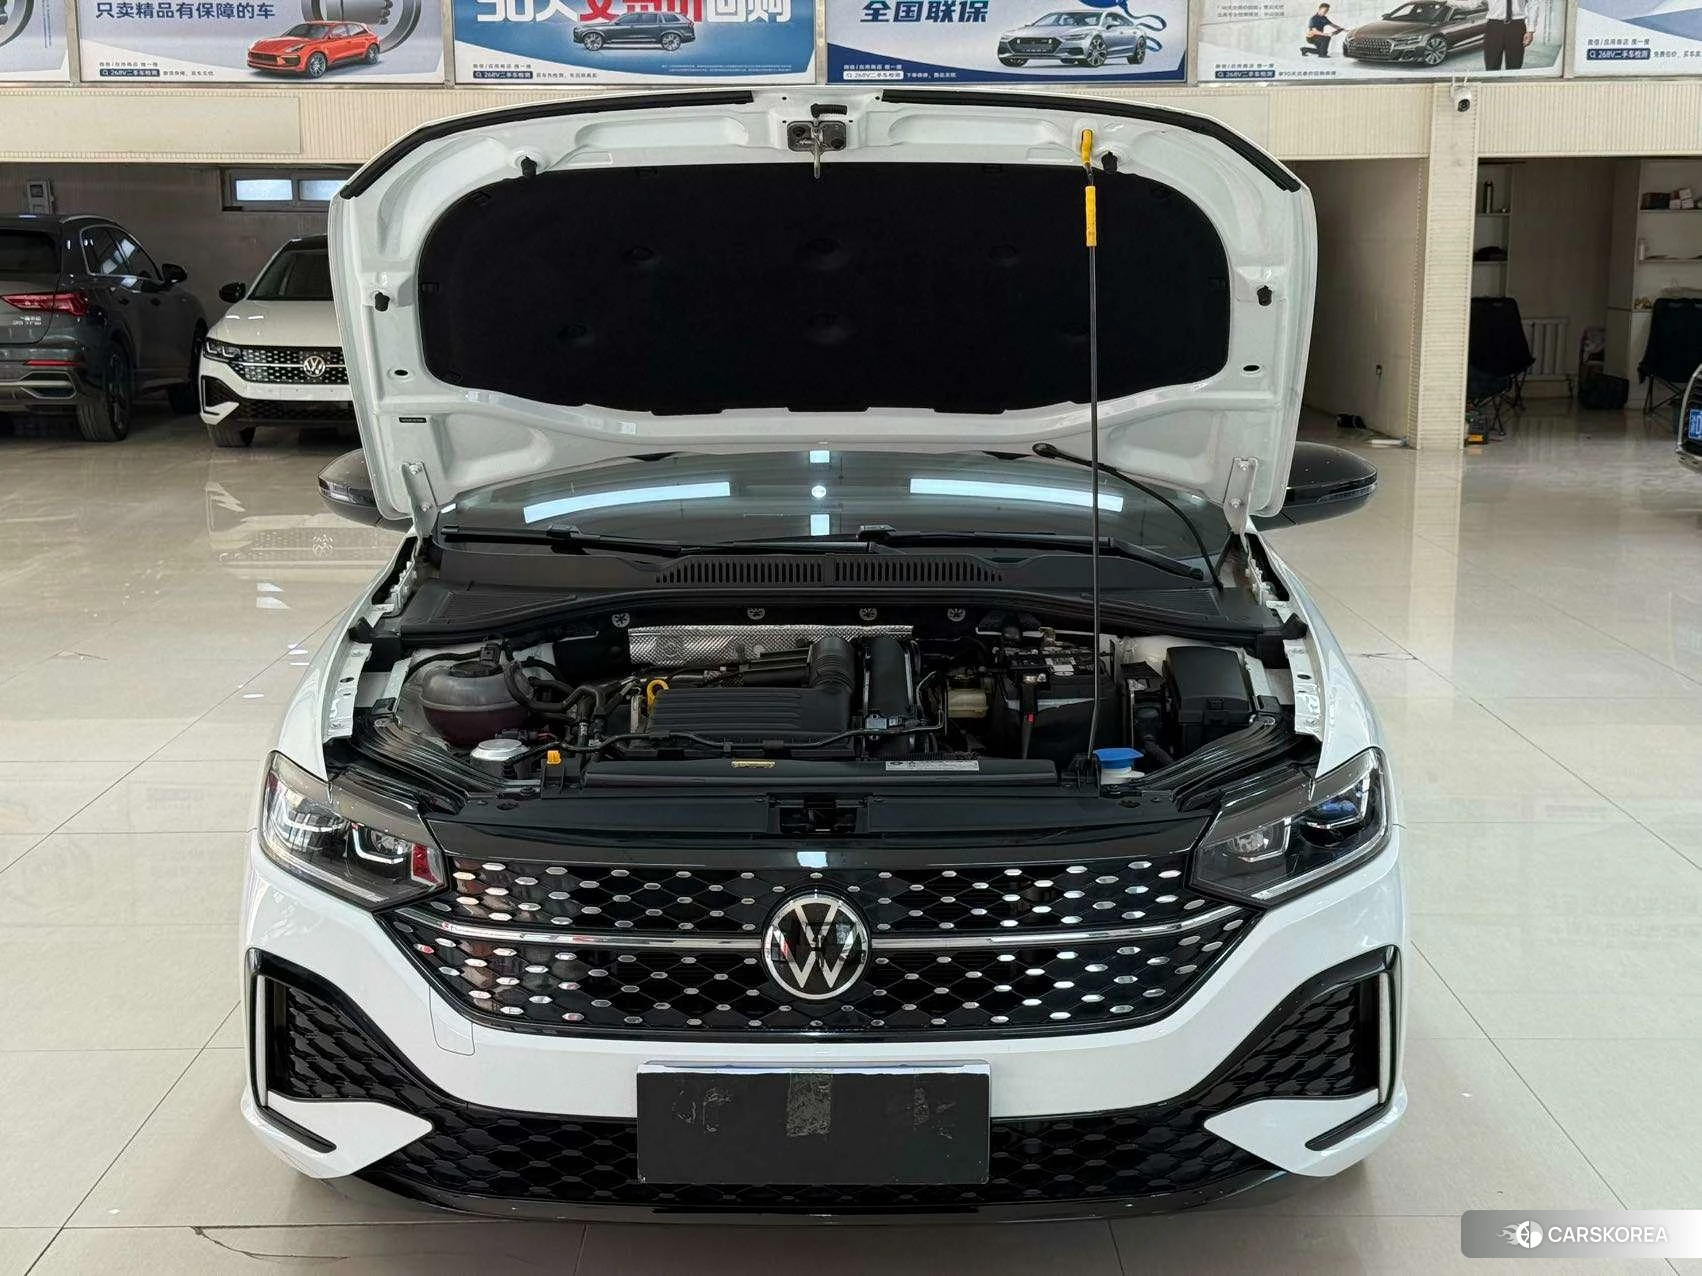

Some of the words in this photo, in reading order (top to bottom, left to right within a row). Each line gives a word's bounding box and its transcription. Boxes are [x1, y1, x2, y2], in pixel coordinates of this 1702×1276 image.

[96, 1, 276, 20] 只卖精品有保障的车
[860, 0, 989, 23] 全国联保
